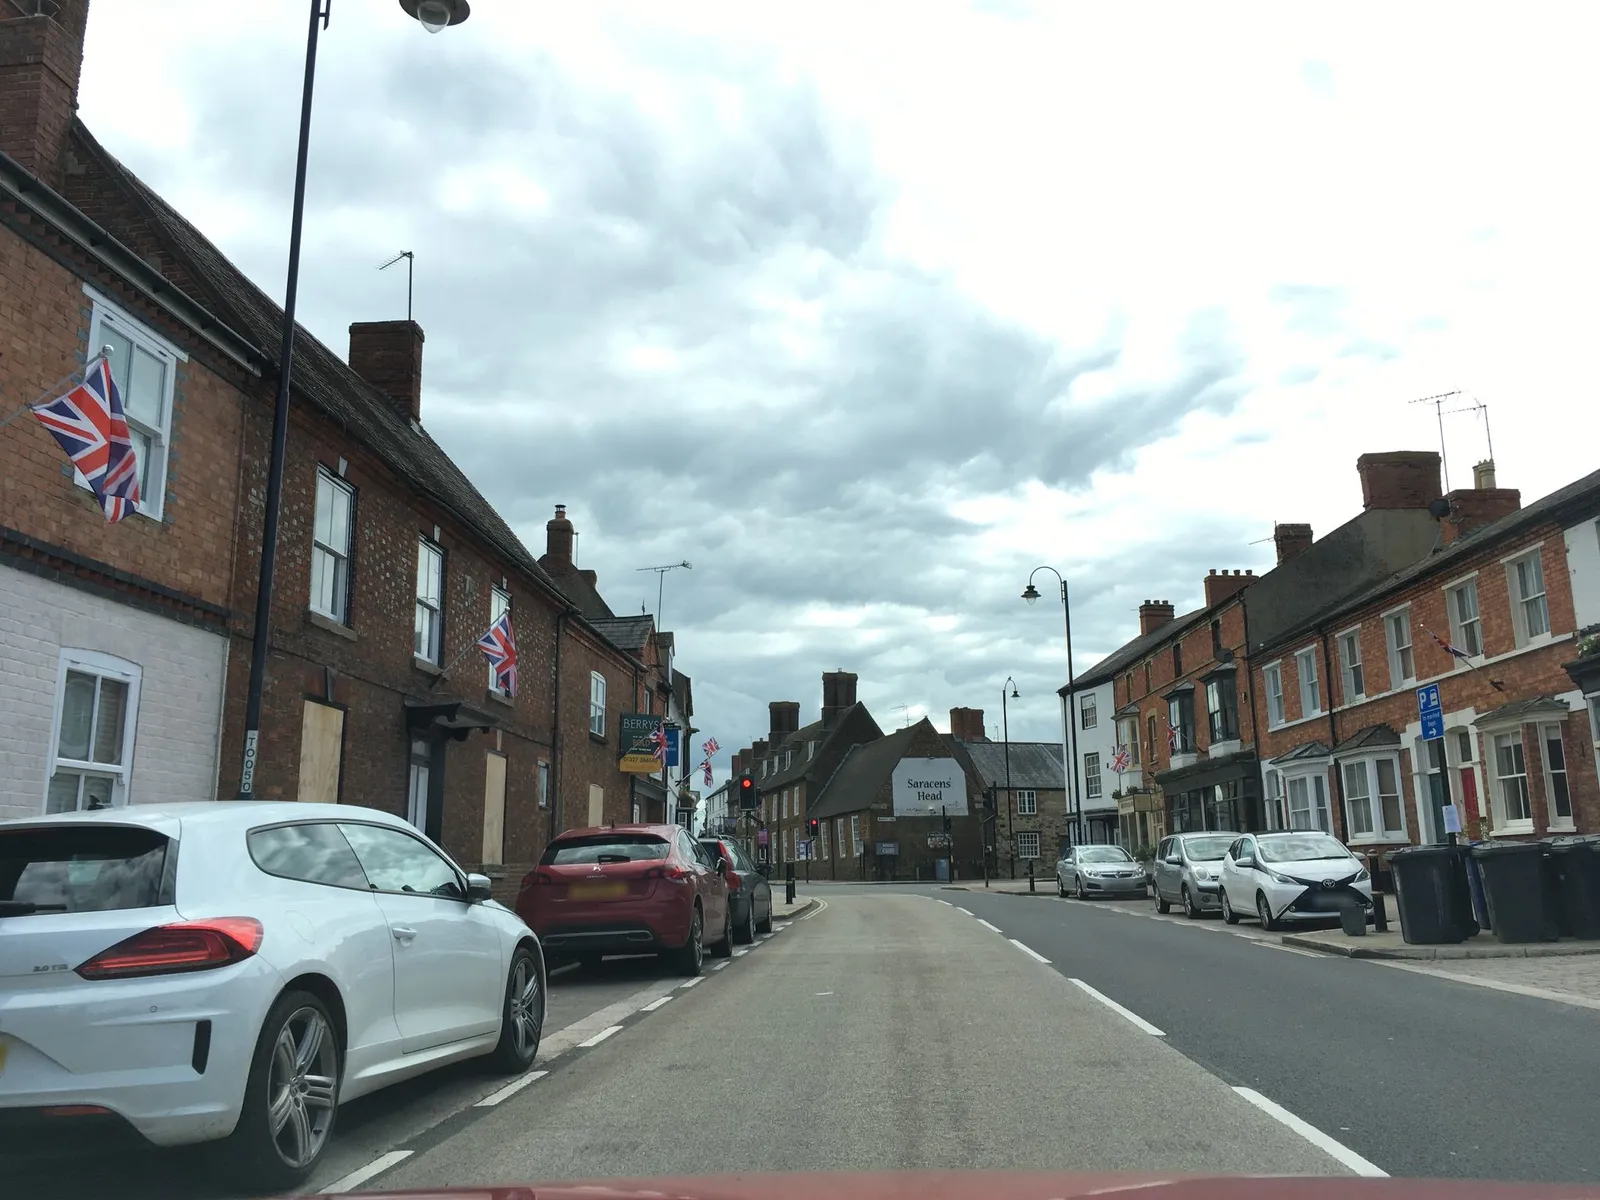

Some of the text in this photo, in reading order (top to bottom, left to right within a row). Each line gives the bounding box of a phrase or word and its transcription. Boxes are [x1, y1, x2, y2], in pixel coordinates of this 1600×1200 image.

[1420, 692, 1426, 709] P
[623, 719, 659, 729] BERRYS
[917, 790, 943, 801] Head
